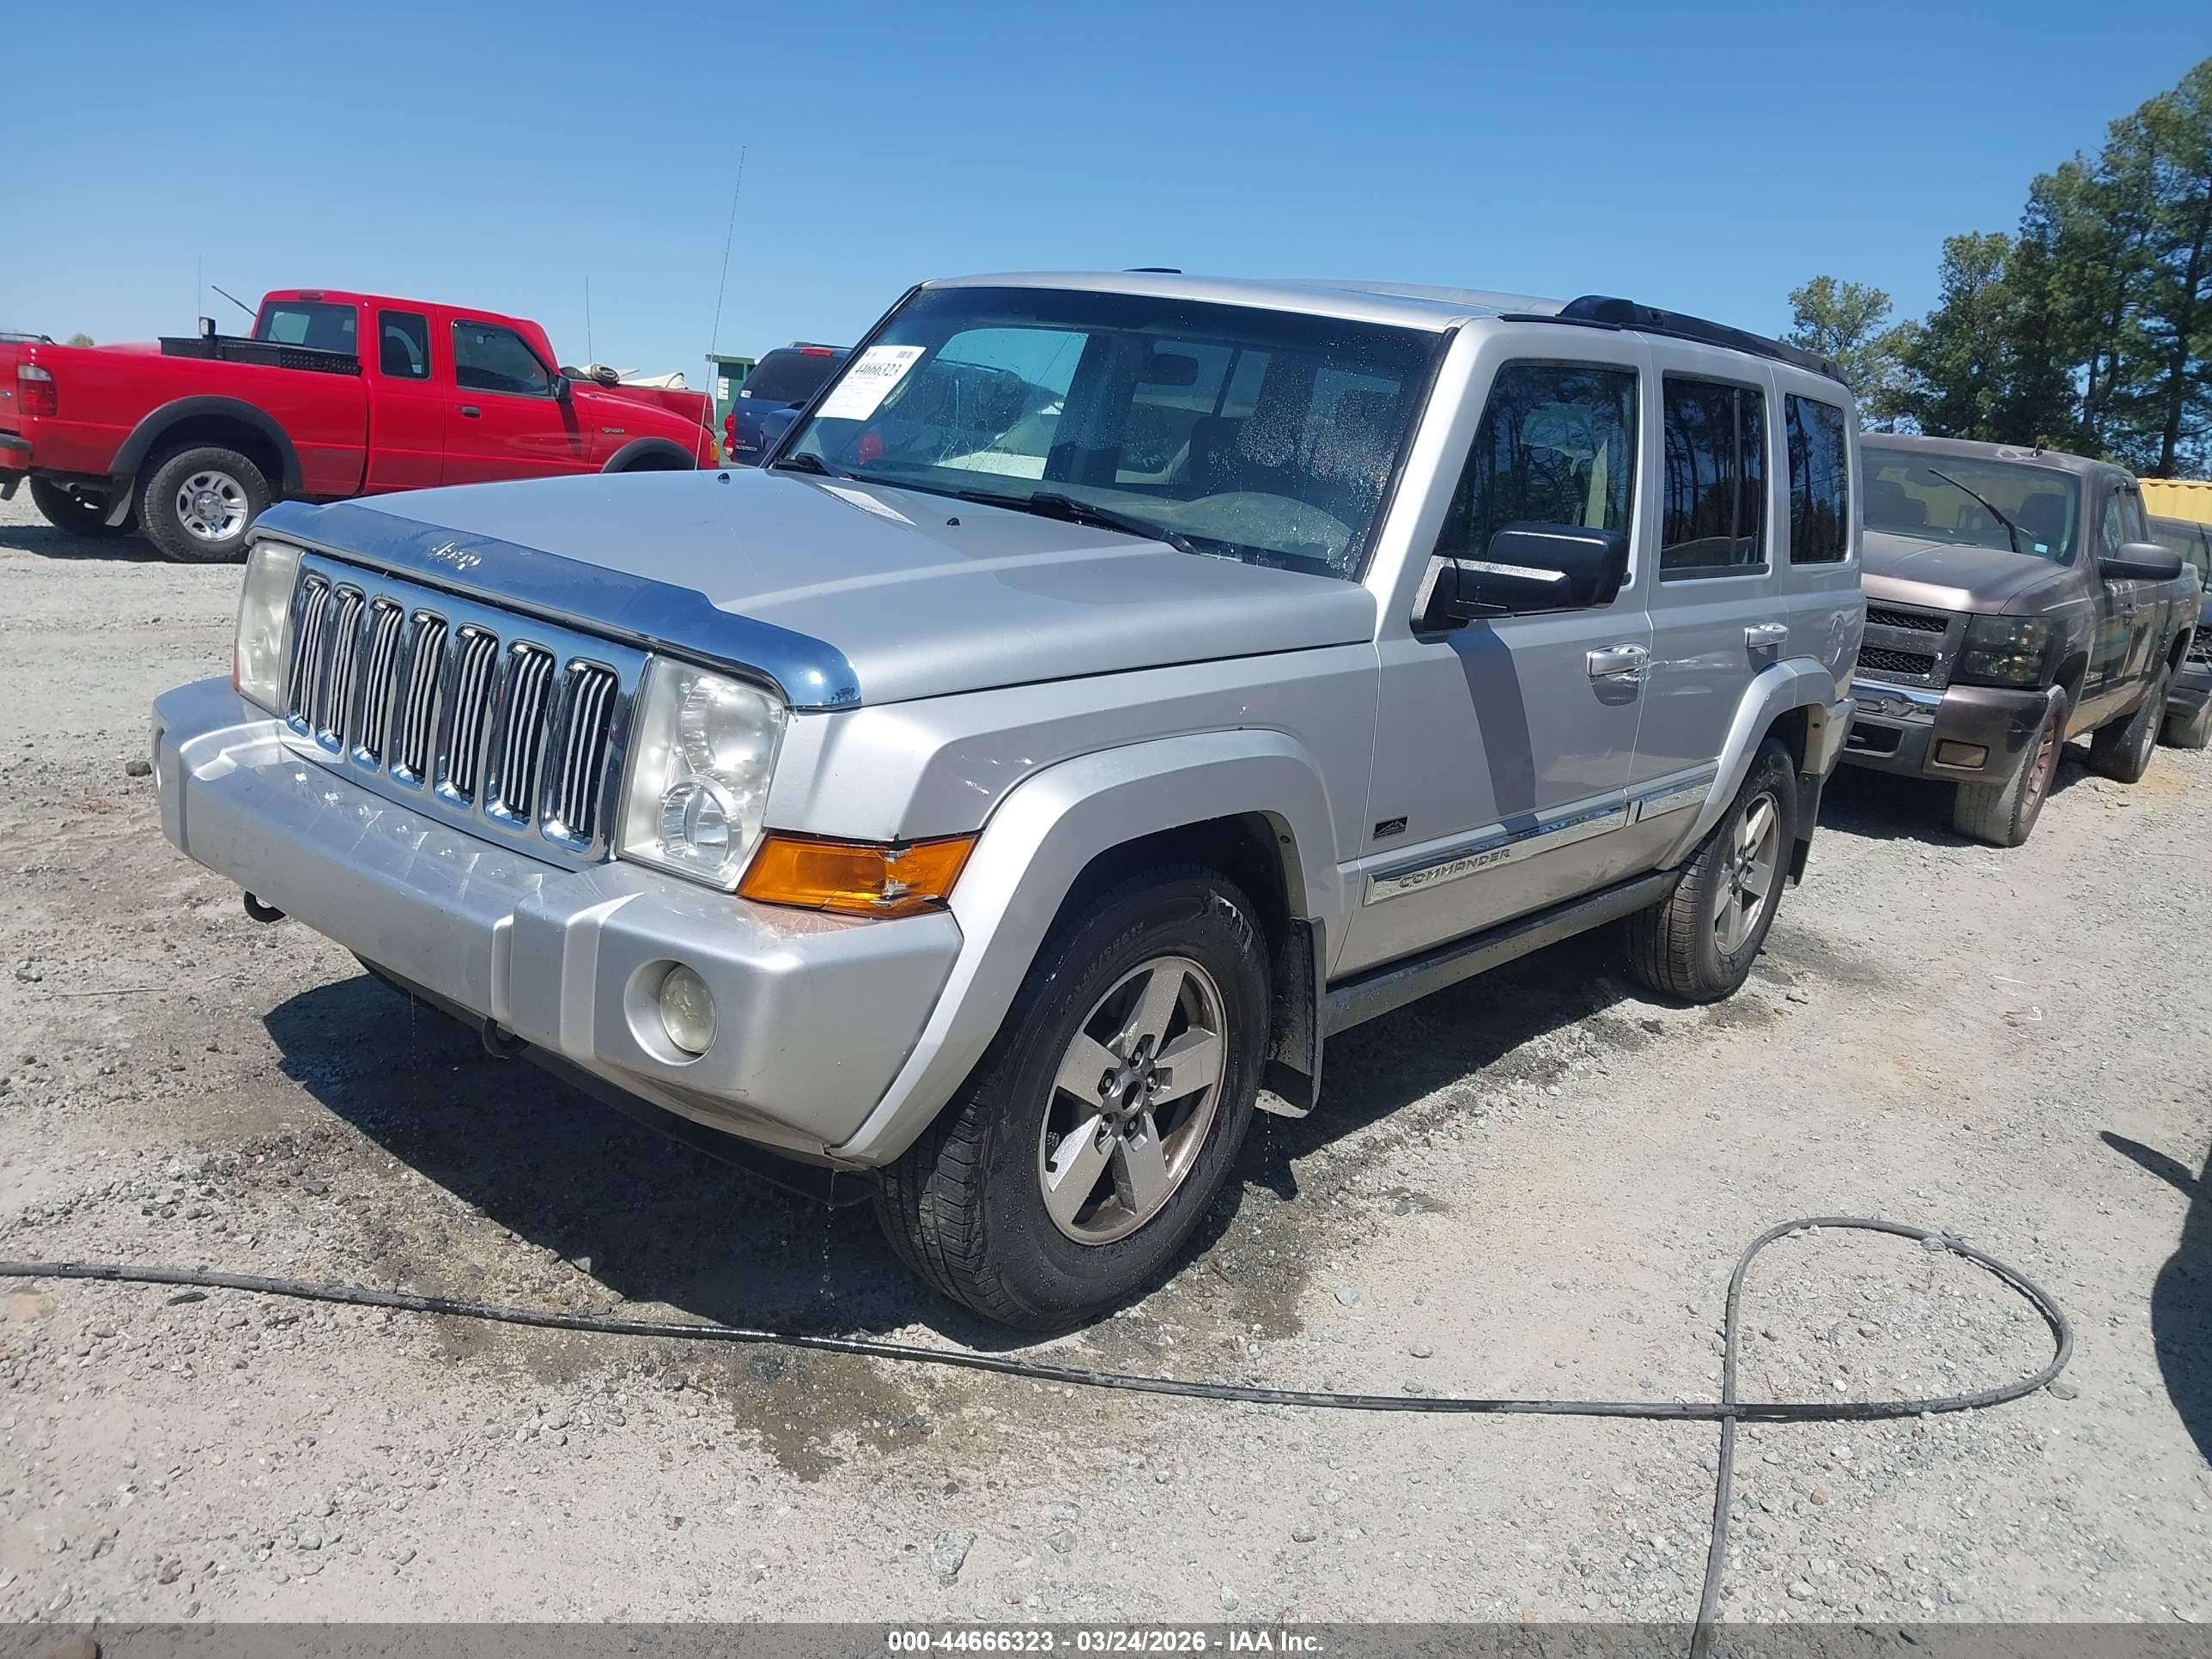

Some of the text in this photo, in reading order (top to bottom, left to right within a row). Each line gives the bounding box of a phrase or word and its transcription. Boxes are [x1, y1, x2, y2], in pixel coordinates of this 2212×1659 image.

[854, 362, 902, 377] 44666323
[431, 541, 483, 571] Jeep
[1399, 848, 1511, 888] COMMANDER
